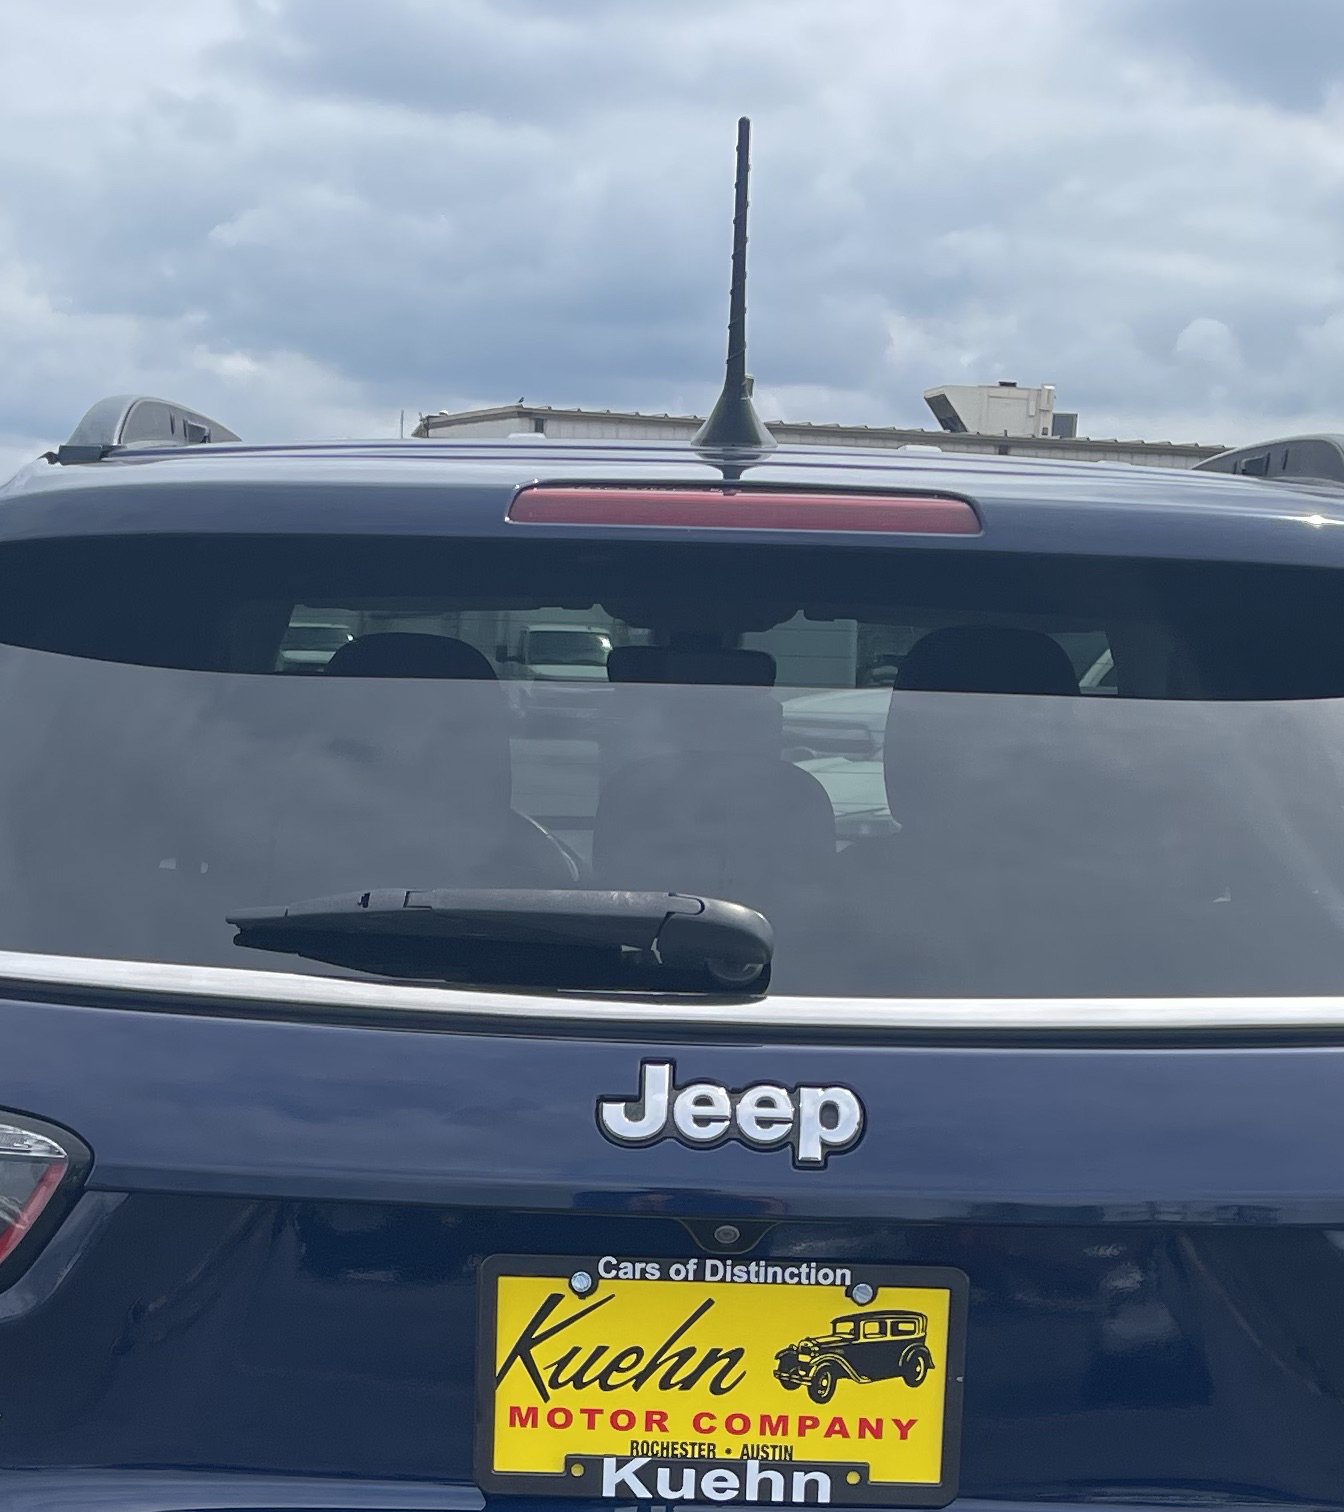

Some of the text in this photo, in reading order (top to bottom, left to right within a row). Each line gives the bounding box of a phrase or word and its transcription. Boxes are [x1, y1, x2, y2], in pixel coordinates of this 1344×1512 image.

[599, 1062, 862, 1162] Jeep
[598, 1256, 852, 1286] Cars of Distinction
[495, 1292, 747, 1403] Kuehn
[509, 1405, 919, 1441] MOTOR COMPANY
[630, 1440, 794, 1461] ROCHESTER AUSTIN
[602, 1457, 831, 1503] Kuehn
